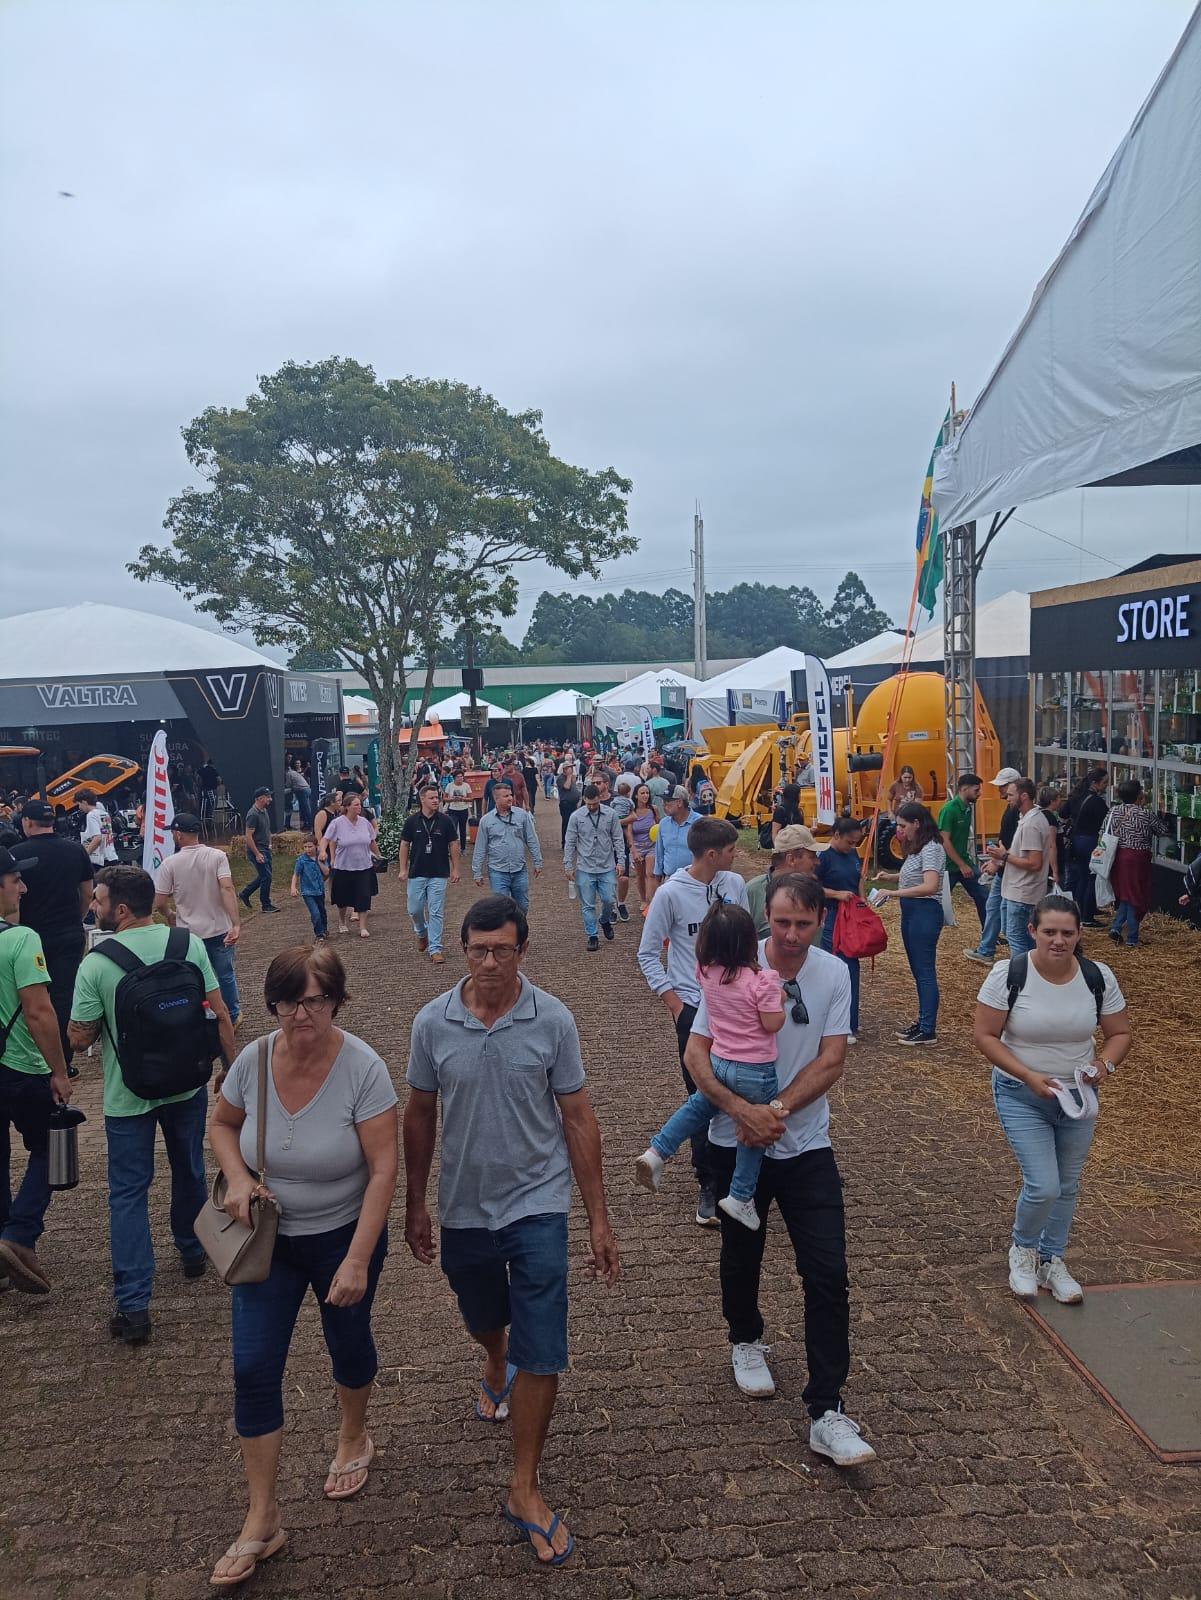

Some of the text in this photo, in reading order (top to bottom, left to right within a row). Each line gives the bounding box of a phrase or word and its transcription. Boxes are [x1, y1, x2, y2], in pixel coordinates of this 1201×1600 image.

[1116, 594, 1190, 643] STORE
[36, 684, 138, 708] VALTRA
[206, 673, 247, 711] V
[814, 680, 829, 773] MEPEL
[153, 745, 167, 845] TRITEC
